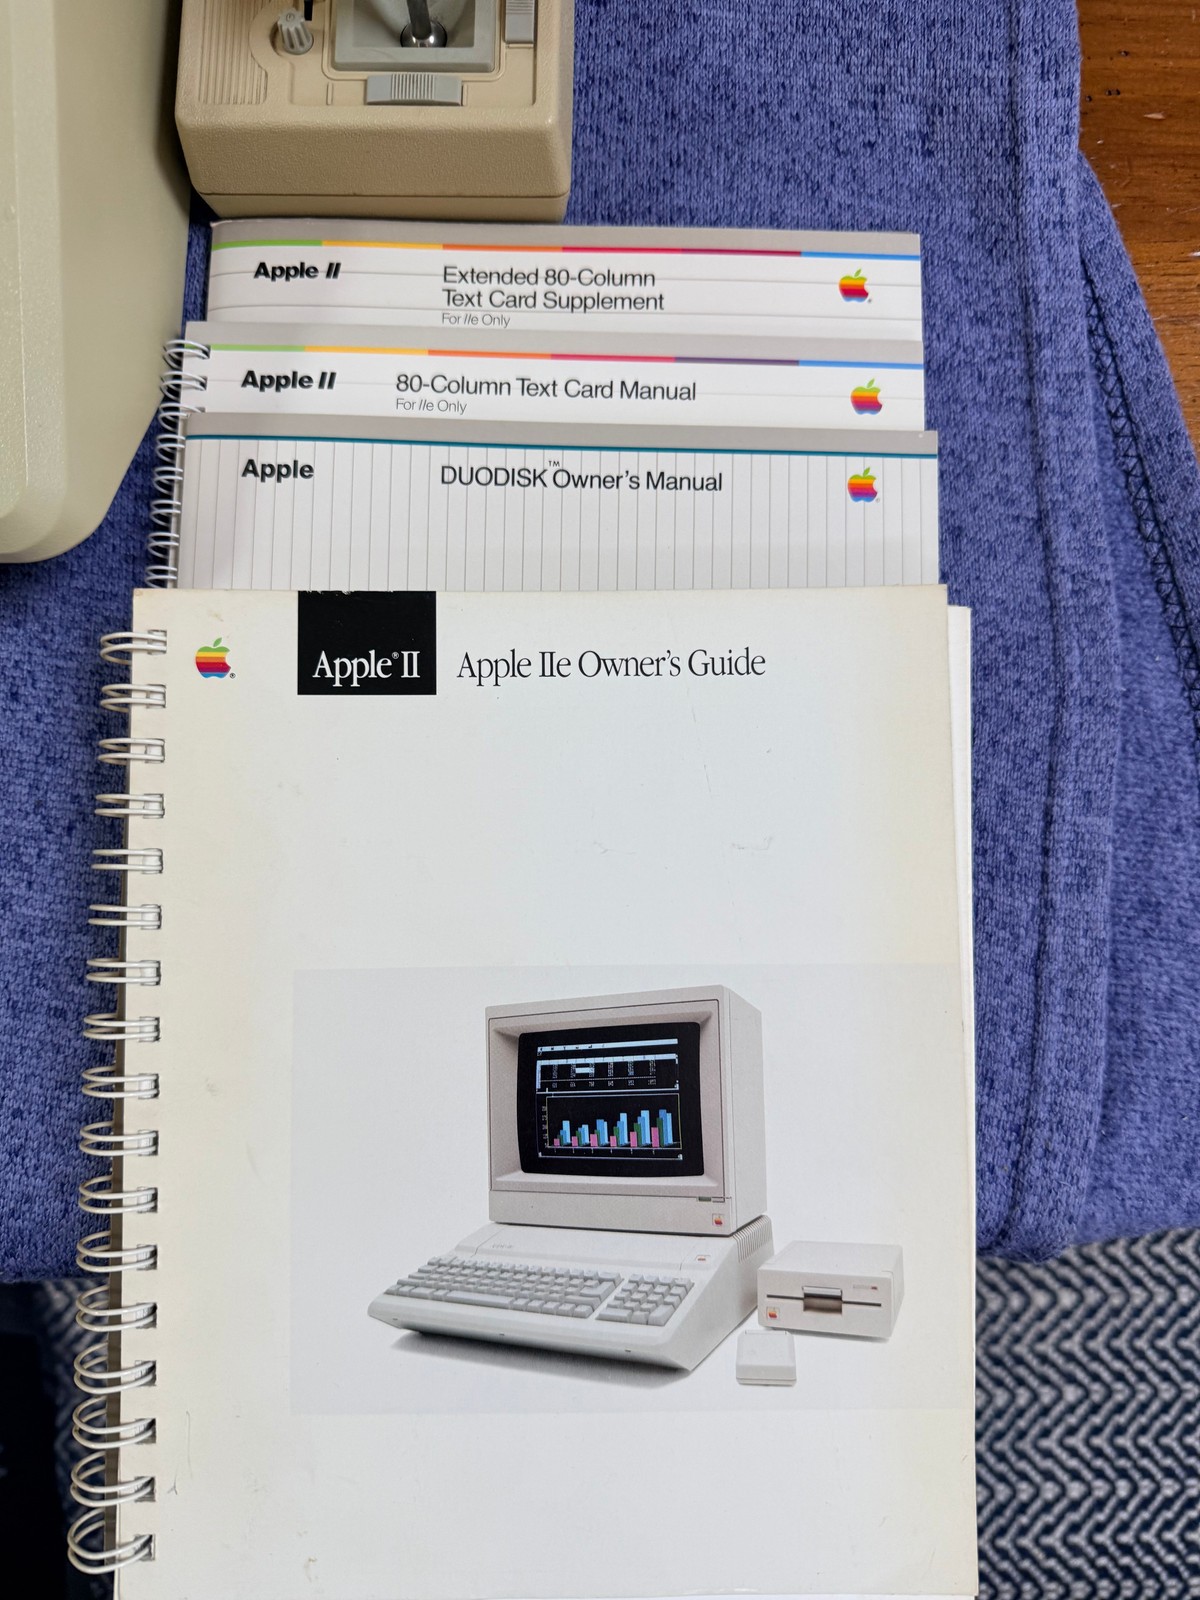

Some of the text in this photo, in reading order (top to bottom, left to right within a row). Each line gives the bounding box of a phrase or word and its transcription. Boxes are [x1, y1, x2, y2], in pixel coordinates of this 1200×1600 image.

[253, 261, 319, 282] Apple
[443, 266, 656, 288] Extended 80-Column
[442, 288, 665, 314] Text Card Supplement
[441, 312, 461, 326] For
[481, 314, 511, 329] Only
[241, 370, 314, 393] Apple
[396, 374, 697, 401] 80-Column Text Card Manual
[396, 398, 416, 411] For
[437, 399, 467, 416] Only
[241, 458, 315, 484] Apple
[552, 468, 641, 490] Owner's
[645, 471, 723, 492] Manual
[400, 650, 421, 678] II
[457, 646, 766, 686] Apple IIe Owner's Guide
